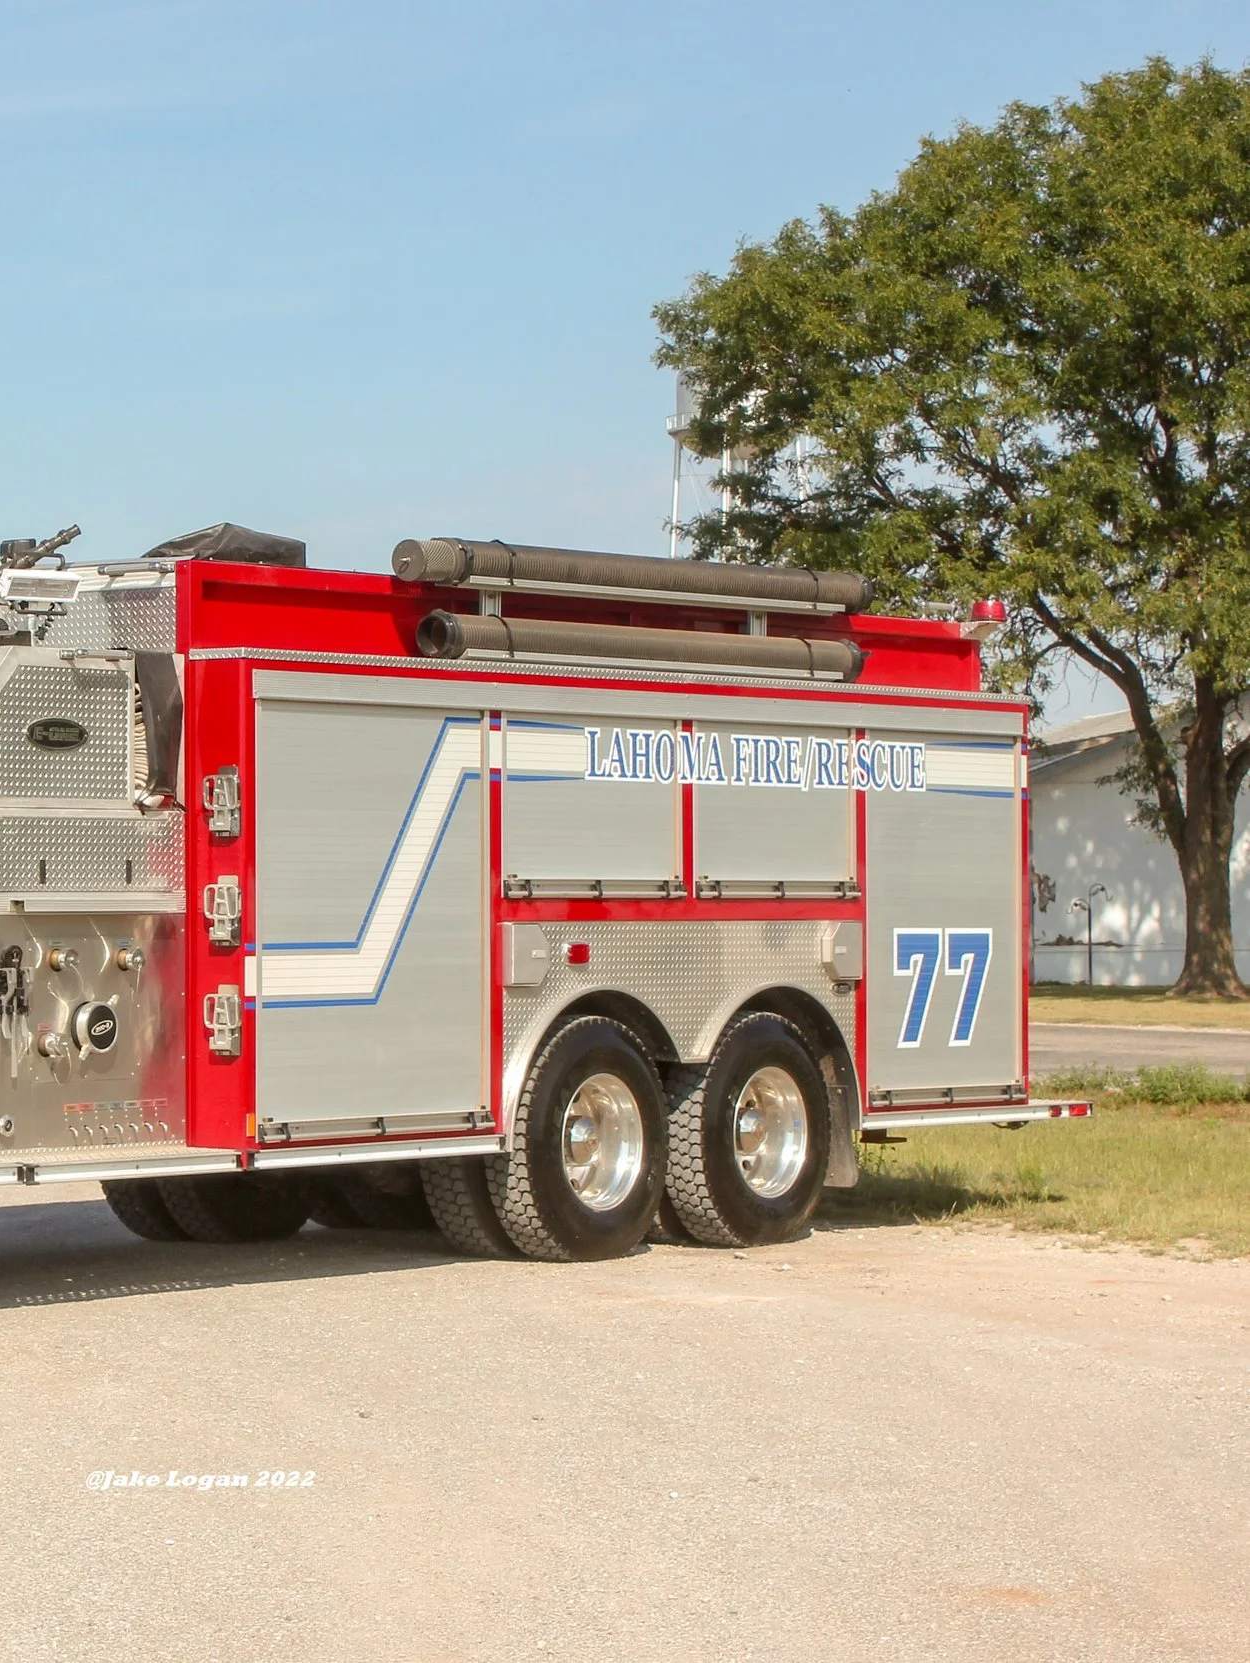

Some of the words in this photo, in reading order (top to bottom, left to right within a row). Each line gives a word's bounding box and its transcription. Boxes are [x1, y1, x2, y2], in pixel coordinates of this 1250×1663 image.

[584, 727, 728, 785] LAHOMA
[730, 733, 926, 792] FIRE/RESCUE
[893, 927, 993, 1048] 77
